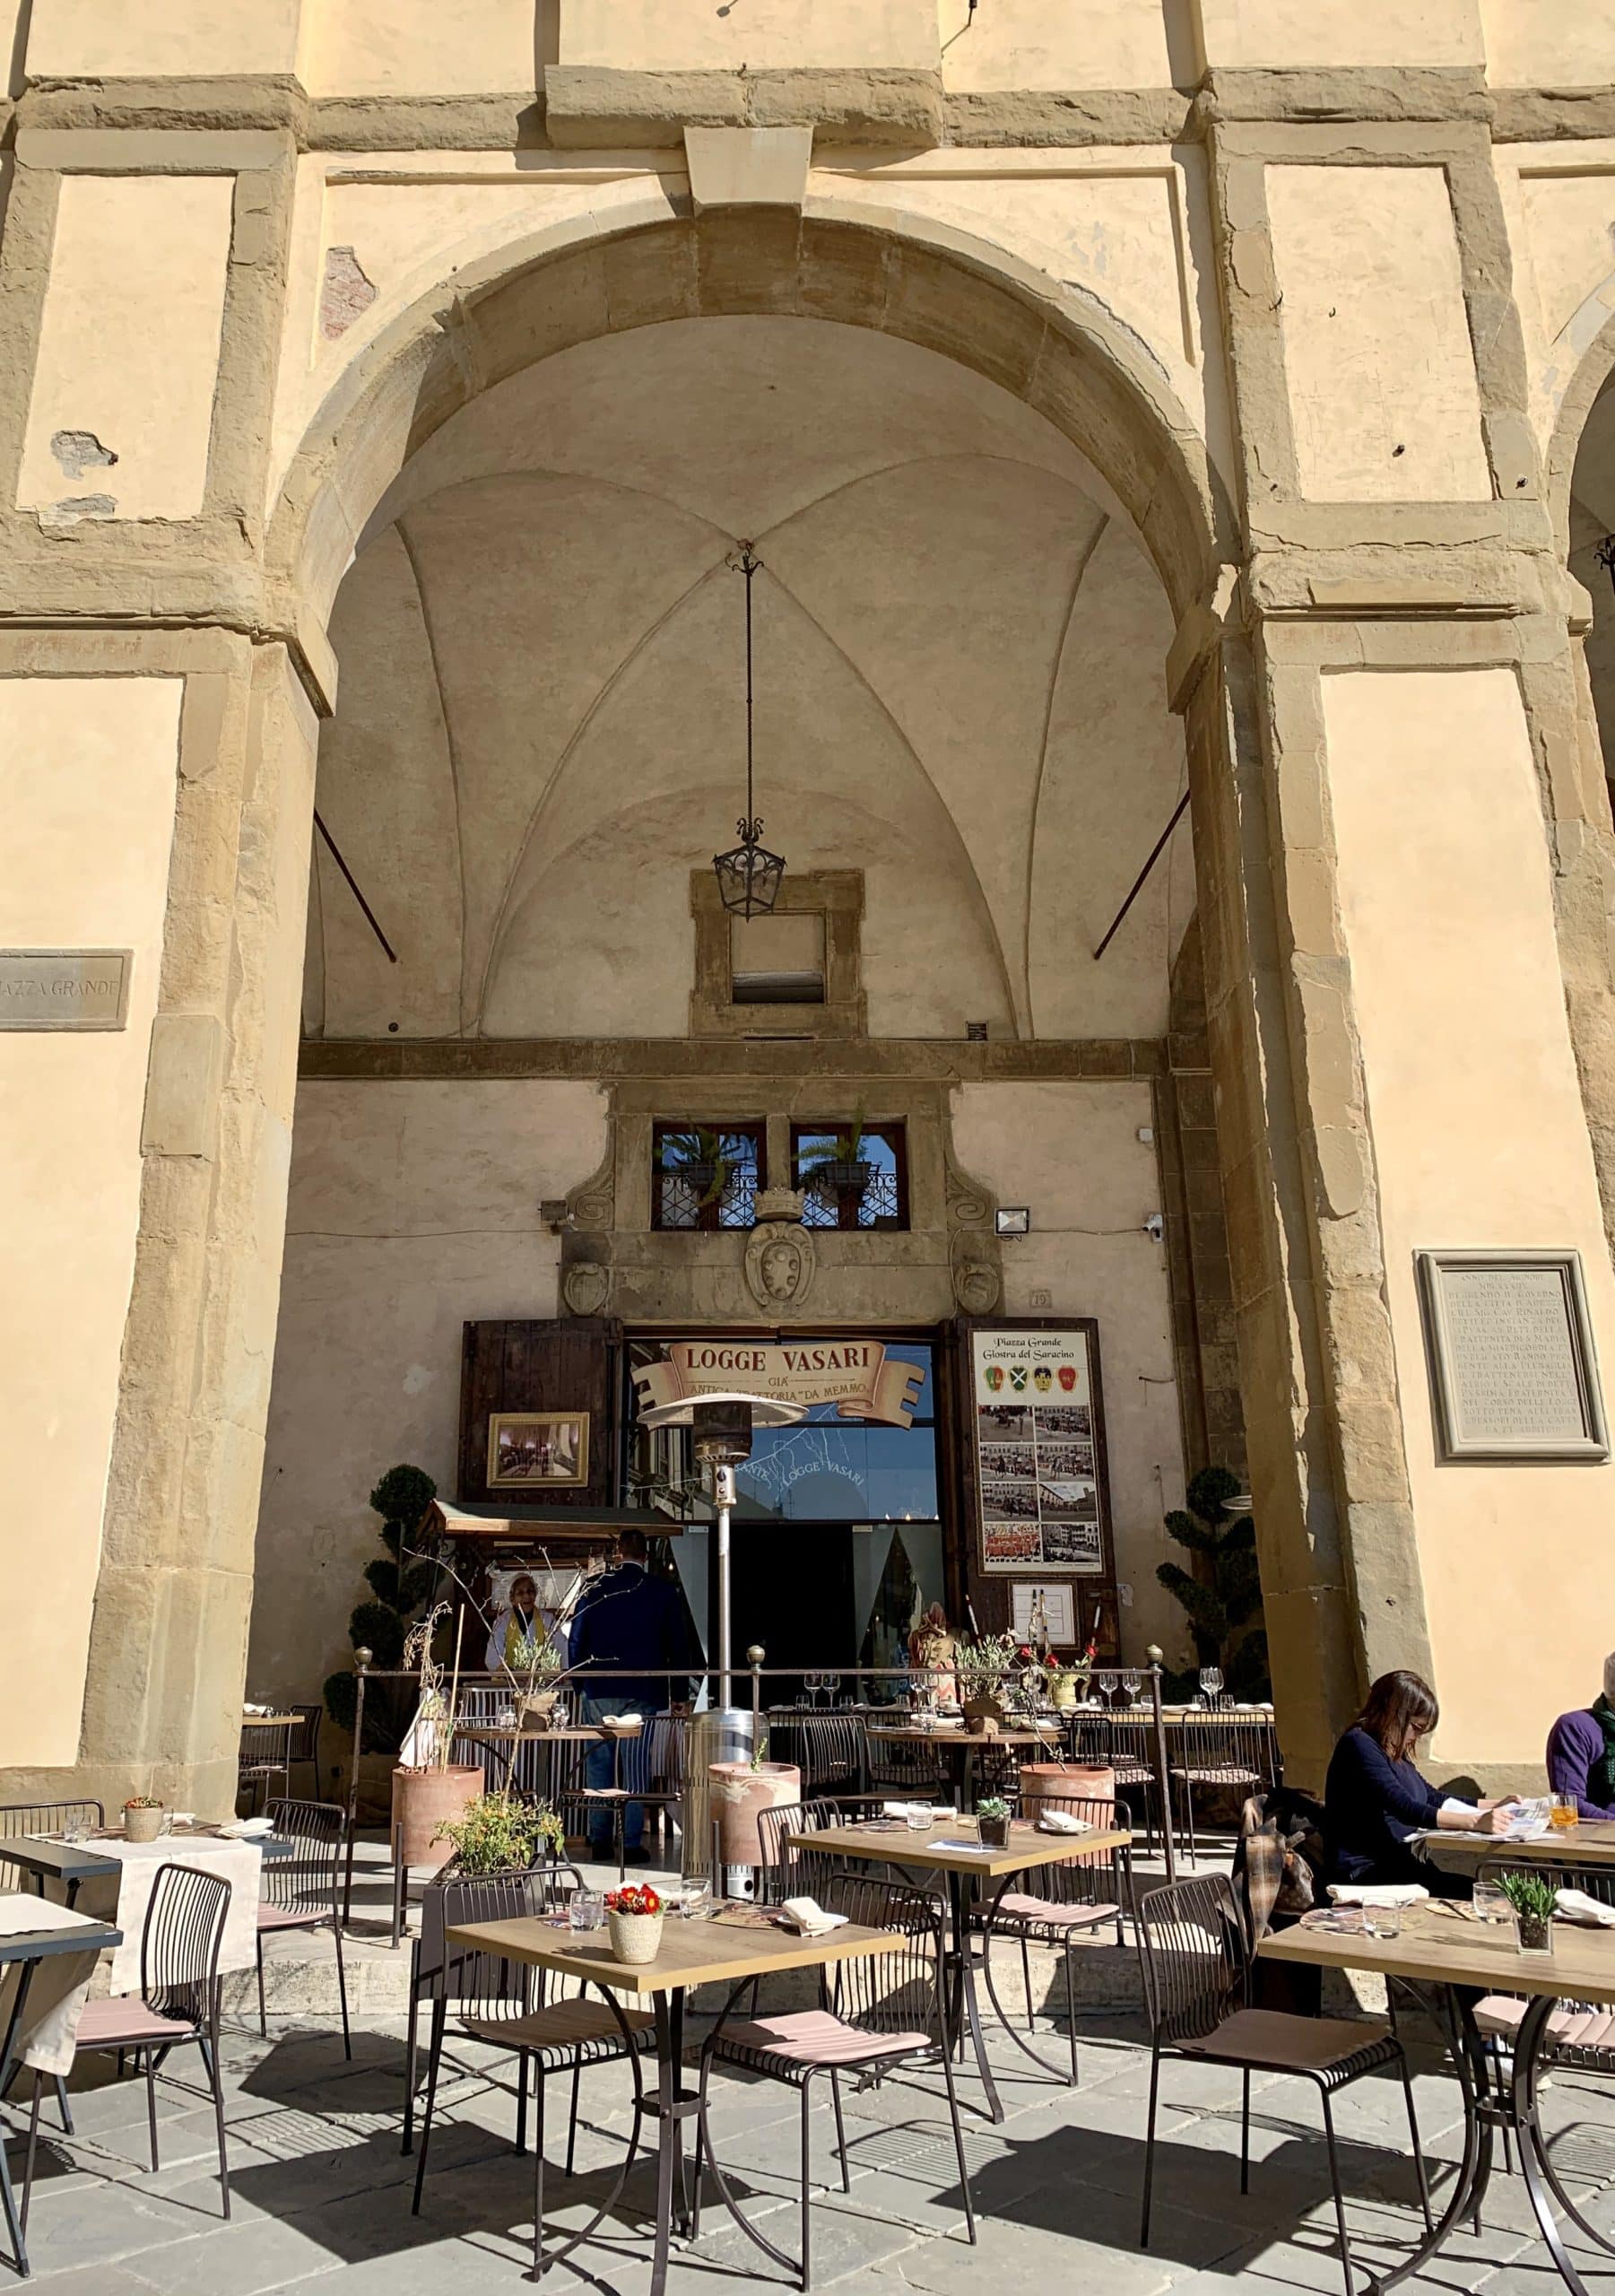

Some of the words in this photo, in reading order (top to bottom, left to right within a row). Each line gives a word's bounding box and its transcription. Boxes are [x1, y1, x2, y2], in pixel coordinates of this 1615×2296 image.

[51, 980, 118, 996] GRANDE
[994, 1337, 1026, 1348] Piazza
[1028, 1337, 1062, 1347] Grande
[687, 1348, 767, 1371] LOGGE
[782, 1347, 870, 1371] VASARI
[1019, 1350, 1030, 1359] del
[1032, 1349, 1074, 1361] Saracino
[783, 1462, 821, 1486] LOGGE
[827, 1461, 865, 1486] VASARI
